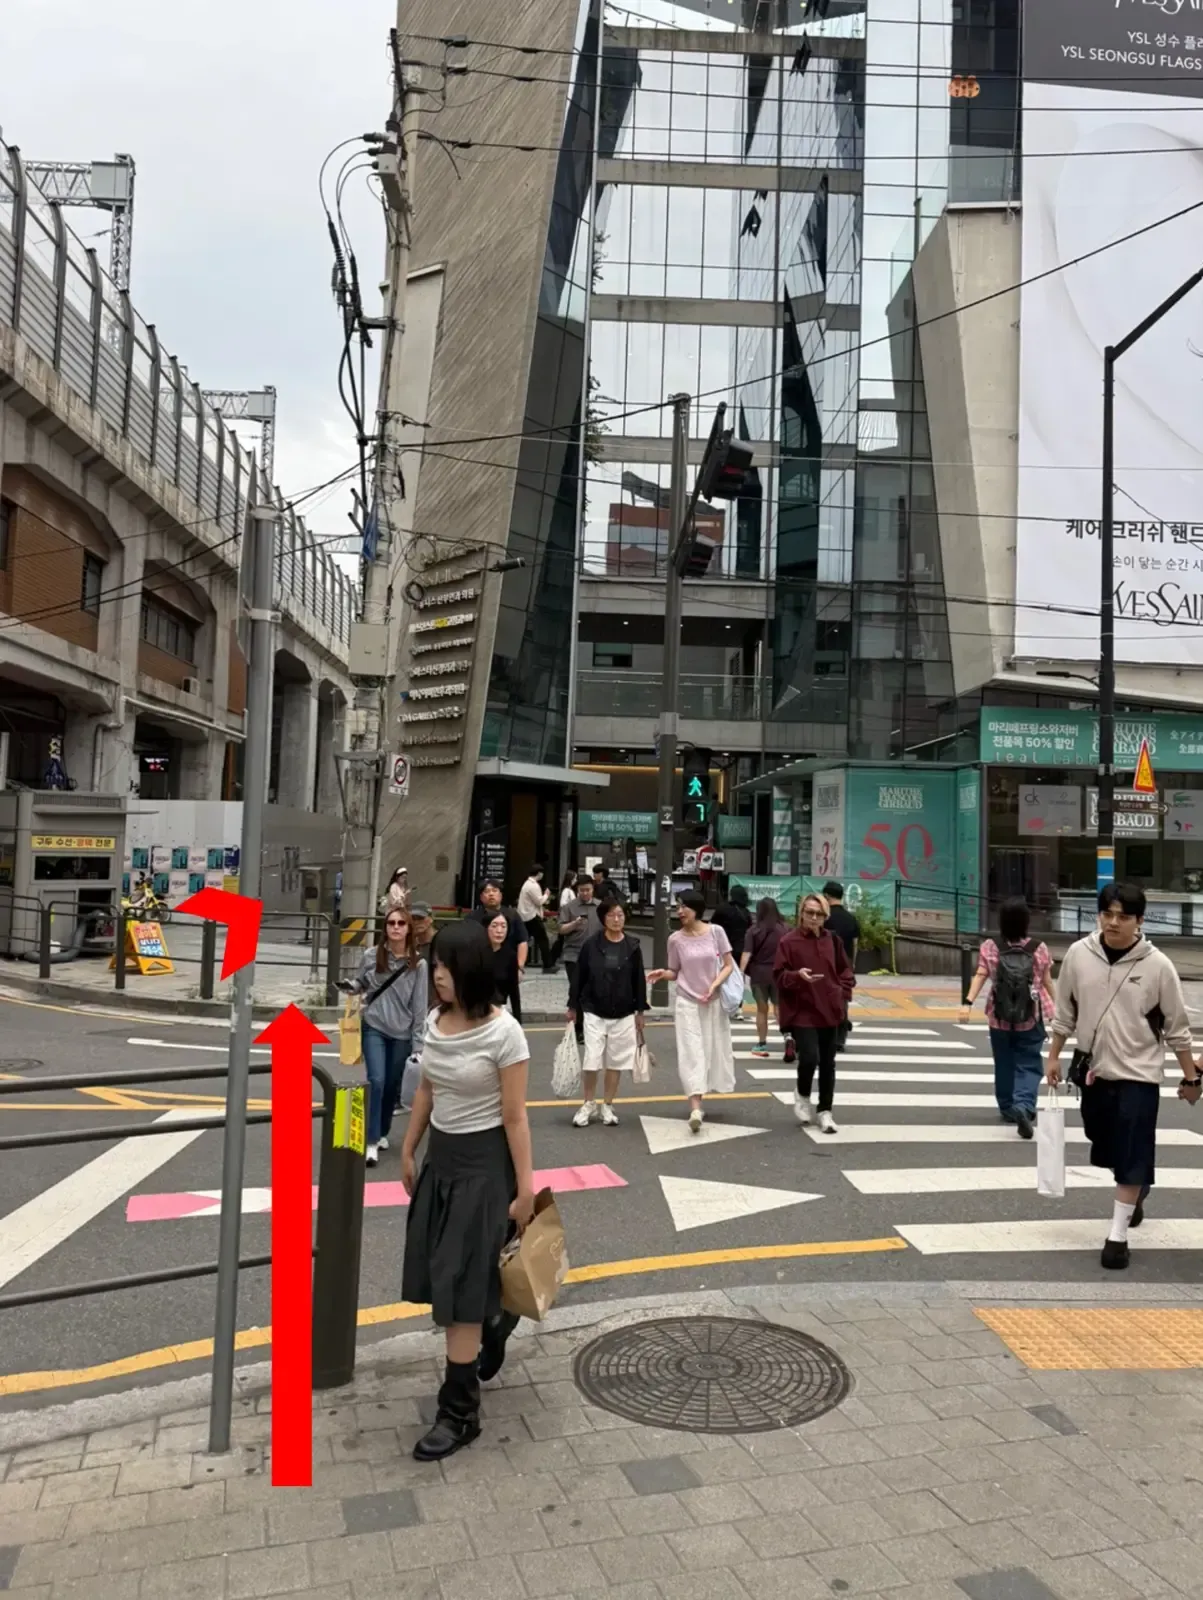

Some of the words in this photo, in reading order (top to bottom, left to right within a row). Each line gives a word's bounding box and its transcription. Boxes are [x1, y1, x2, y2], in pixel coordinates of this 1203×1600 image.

[1127, 31, 1151, 45] YSL
[1154, 33, 1180, 48] 성수
[1061, 45, 1085, 59] YSL
[1089, 48, 1155, 66] SEONGSU
[1160, 55, 1202, 70] FLAGS
[1066, 520, 1102, 539] 케어
[1165, 558, 1188, 571] 순간
[1025, 738, 1052, 748] 50%
[1054, 738, 1074, 750] 할인
[996, 752, 1037, 764] teal
[36, 837, 52, 846] 구두
[95, 839, 111, 848] 전문
[859, 823, 933, 880] 50
